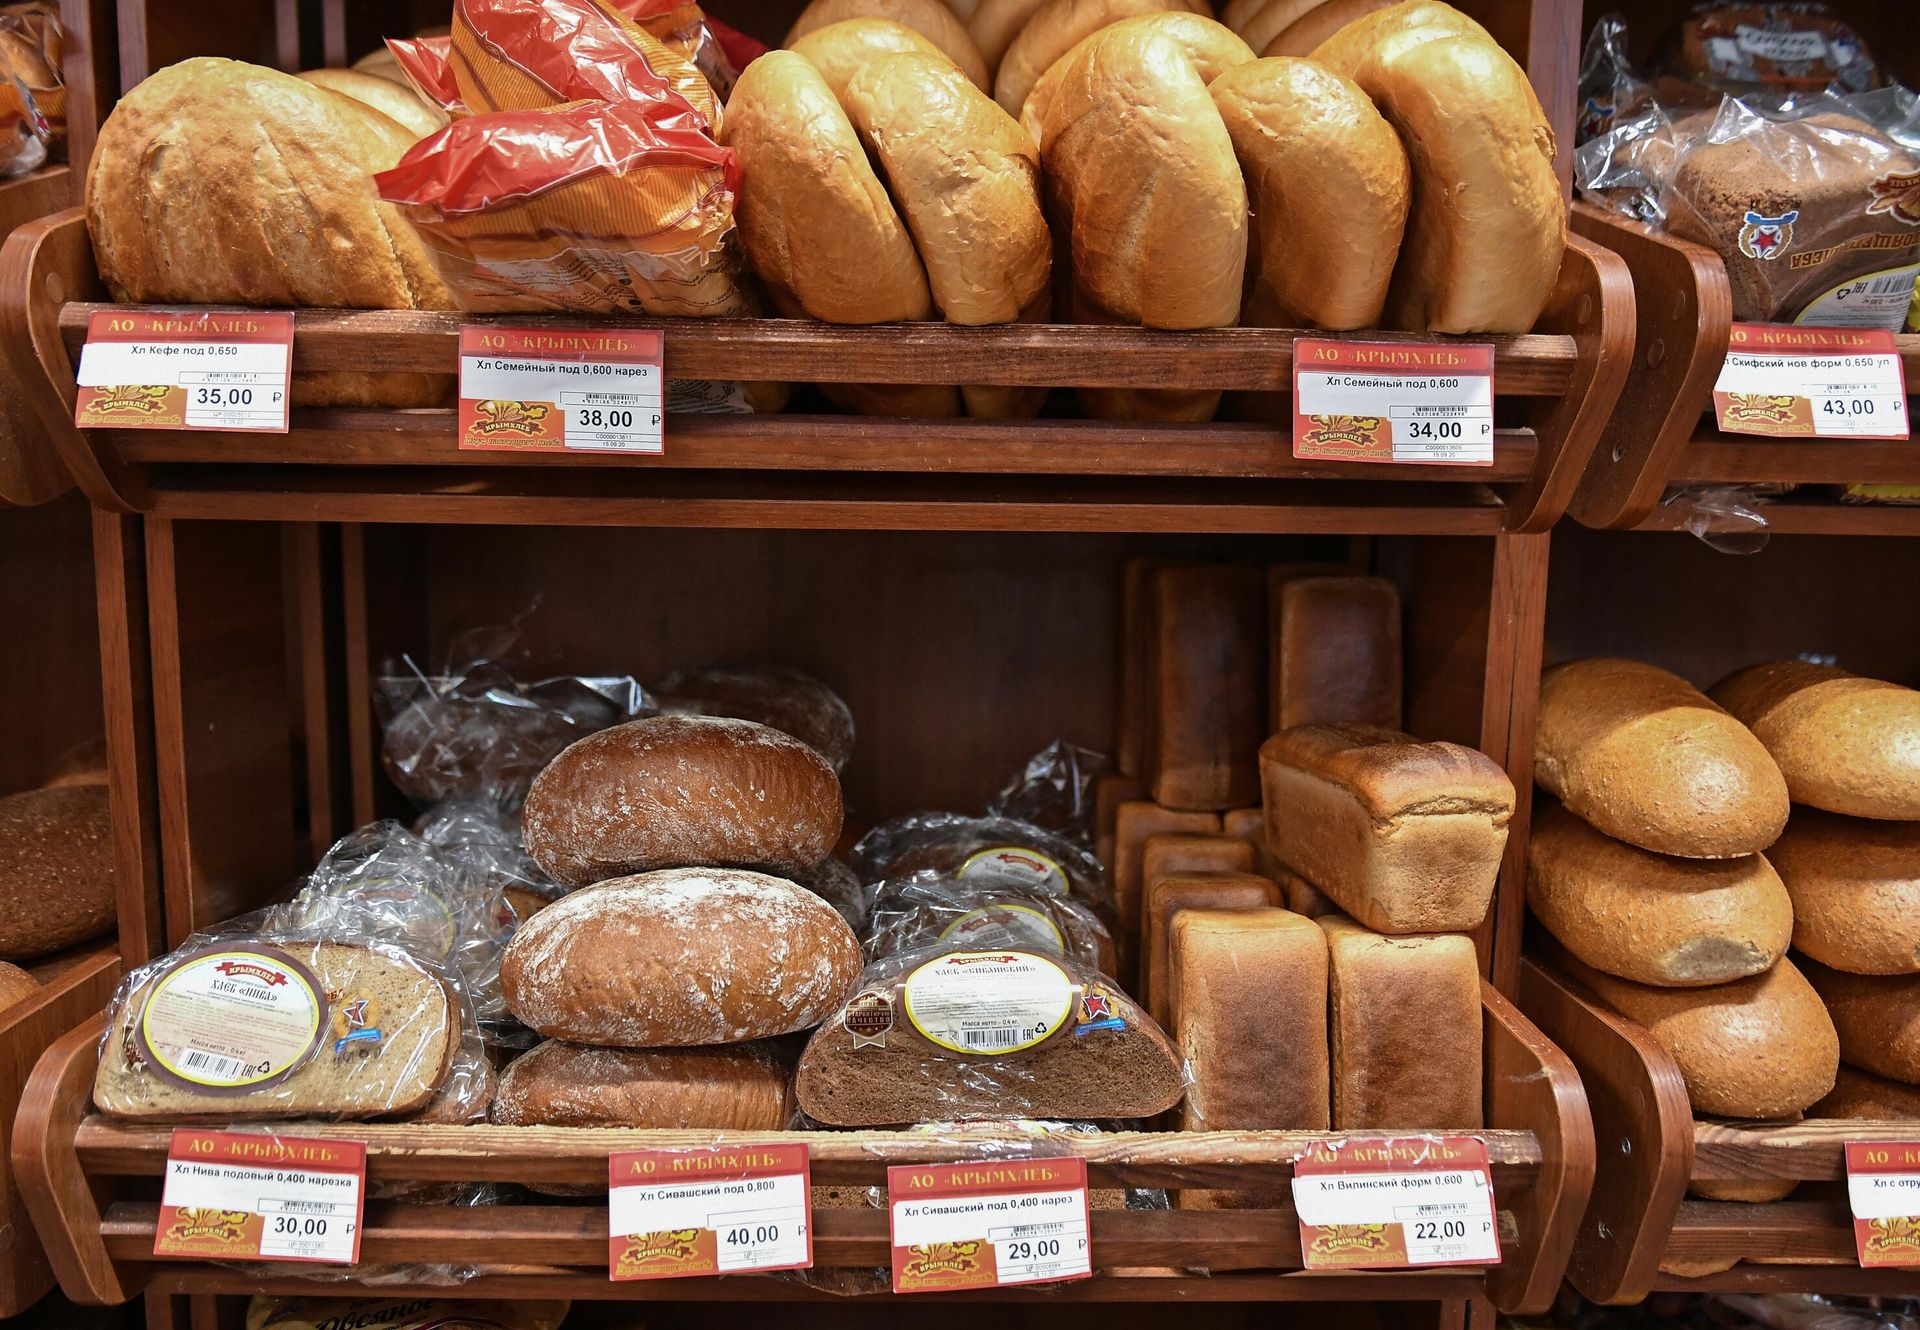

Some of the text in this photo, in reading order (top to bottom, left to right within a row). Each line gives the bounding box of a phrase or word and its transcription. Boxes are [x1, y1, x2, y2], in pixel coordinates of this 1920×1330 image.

[108, 319, 135, 331] АО
[480, 335, 636, 352] АО «КРЫМХЛЕБ»
[1756, 332, 1871, 345] «КРЫМХЛЕБ»
[131, 346, 237, 356] Хл Кефе под 0,650
[1314, 348, 1466, 365] АО «КРЫМХЛЕБ»
[477, 360, 647, 377] Хл Семейный под 0,600 нарез
[1732, 358, 1784, 368] Скифский
[1787, 359, 1807, 368] нов
[1811, 360, 1841, 369] форм
[1845, 358, 1873, 367] 0,650
[1877, 359, 1890, 368] уп
[1326, 376, 1459, 389] Хл Семейный под 0,600
[197, 388, 253, 408] 35,00
[1823, 400, 1874, 417] 43,00
[485, 422, 530, 432] КРЫМХЛЕБ
[580, 410, 632, 429] 38,00
[1319, 432, 1362, 442] КРЫМХЛЕБ
[1409, 422, 1461, 441] 34,00
[229, 966, 276, 983] КРЫМХЛЕБ
[189, 1139, 339, 1162] АО «КРЫМХЛЕБ»
[1314, 1150, 1338, 1163] АО
[1866, 1151, 1889, 1164] АО
[630, 1153, 782, 1174] АО «КРЫМХЛЕБ»
[175, 1164, 352, 1187] Хл Нива подовый 0,400 нарезка
[909, 1168, 1060, 1188] АО «КРЫМХЛЕБ»
[1320, 1175, 1463, 1191] Хл Вилинский форм 0,600
[1874, 1179, 1886, 1187] Хл
[640, 1181, 775, 1201] Хл Сивашский под 0,800
[905, 1196, 1073, 1216] Хл Сивашский под 0,400 нарез
[274, 1217, 327, 1238] 30,00
[727, 1225, 779, 1247] 40,00
[1415, 1221, 1466, 1242] 22,00
[1008, 1239, 1060, 1261] 29,00
[920, 1261, 964, 1272] КРЫМХЛЕБ
